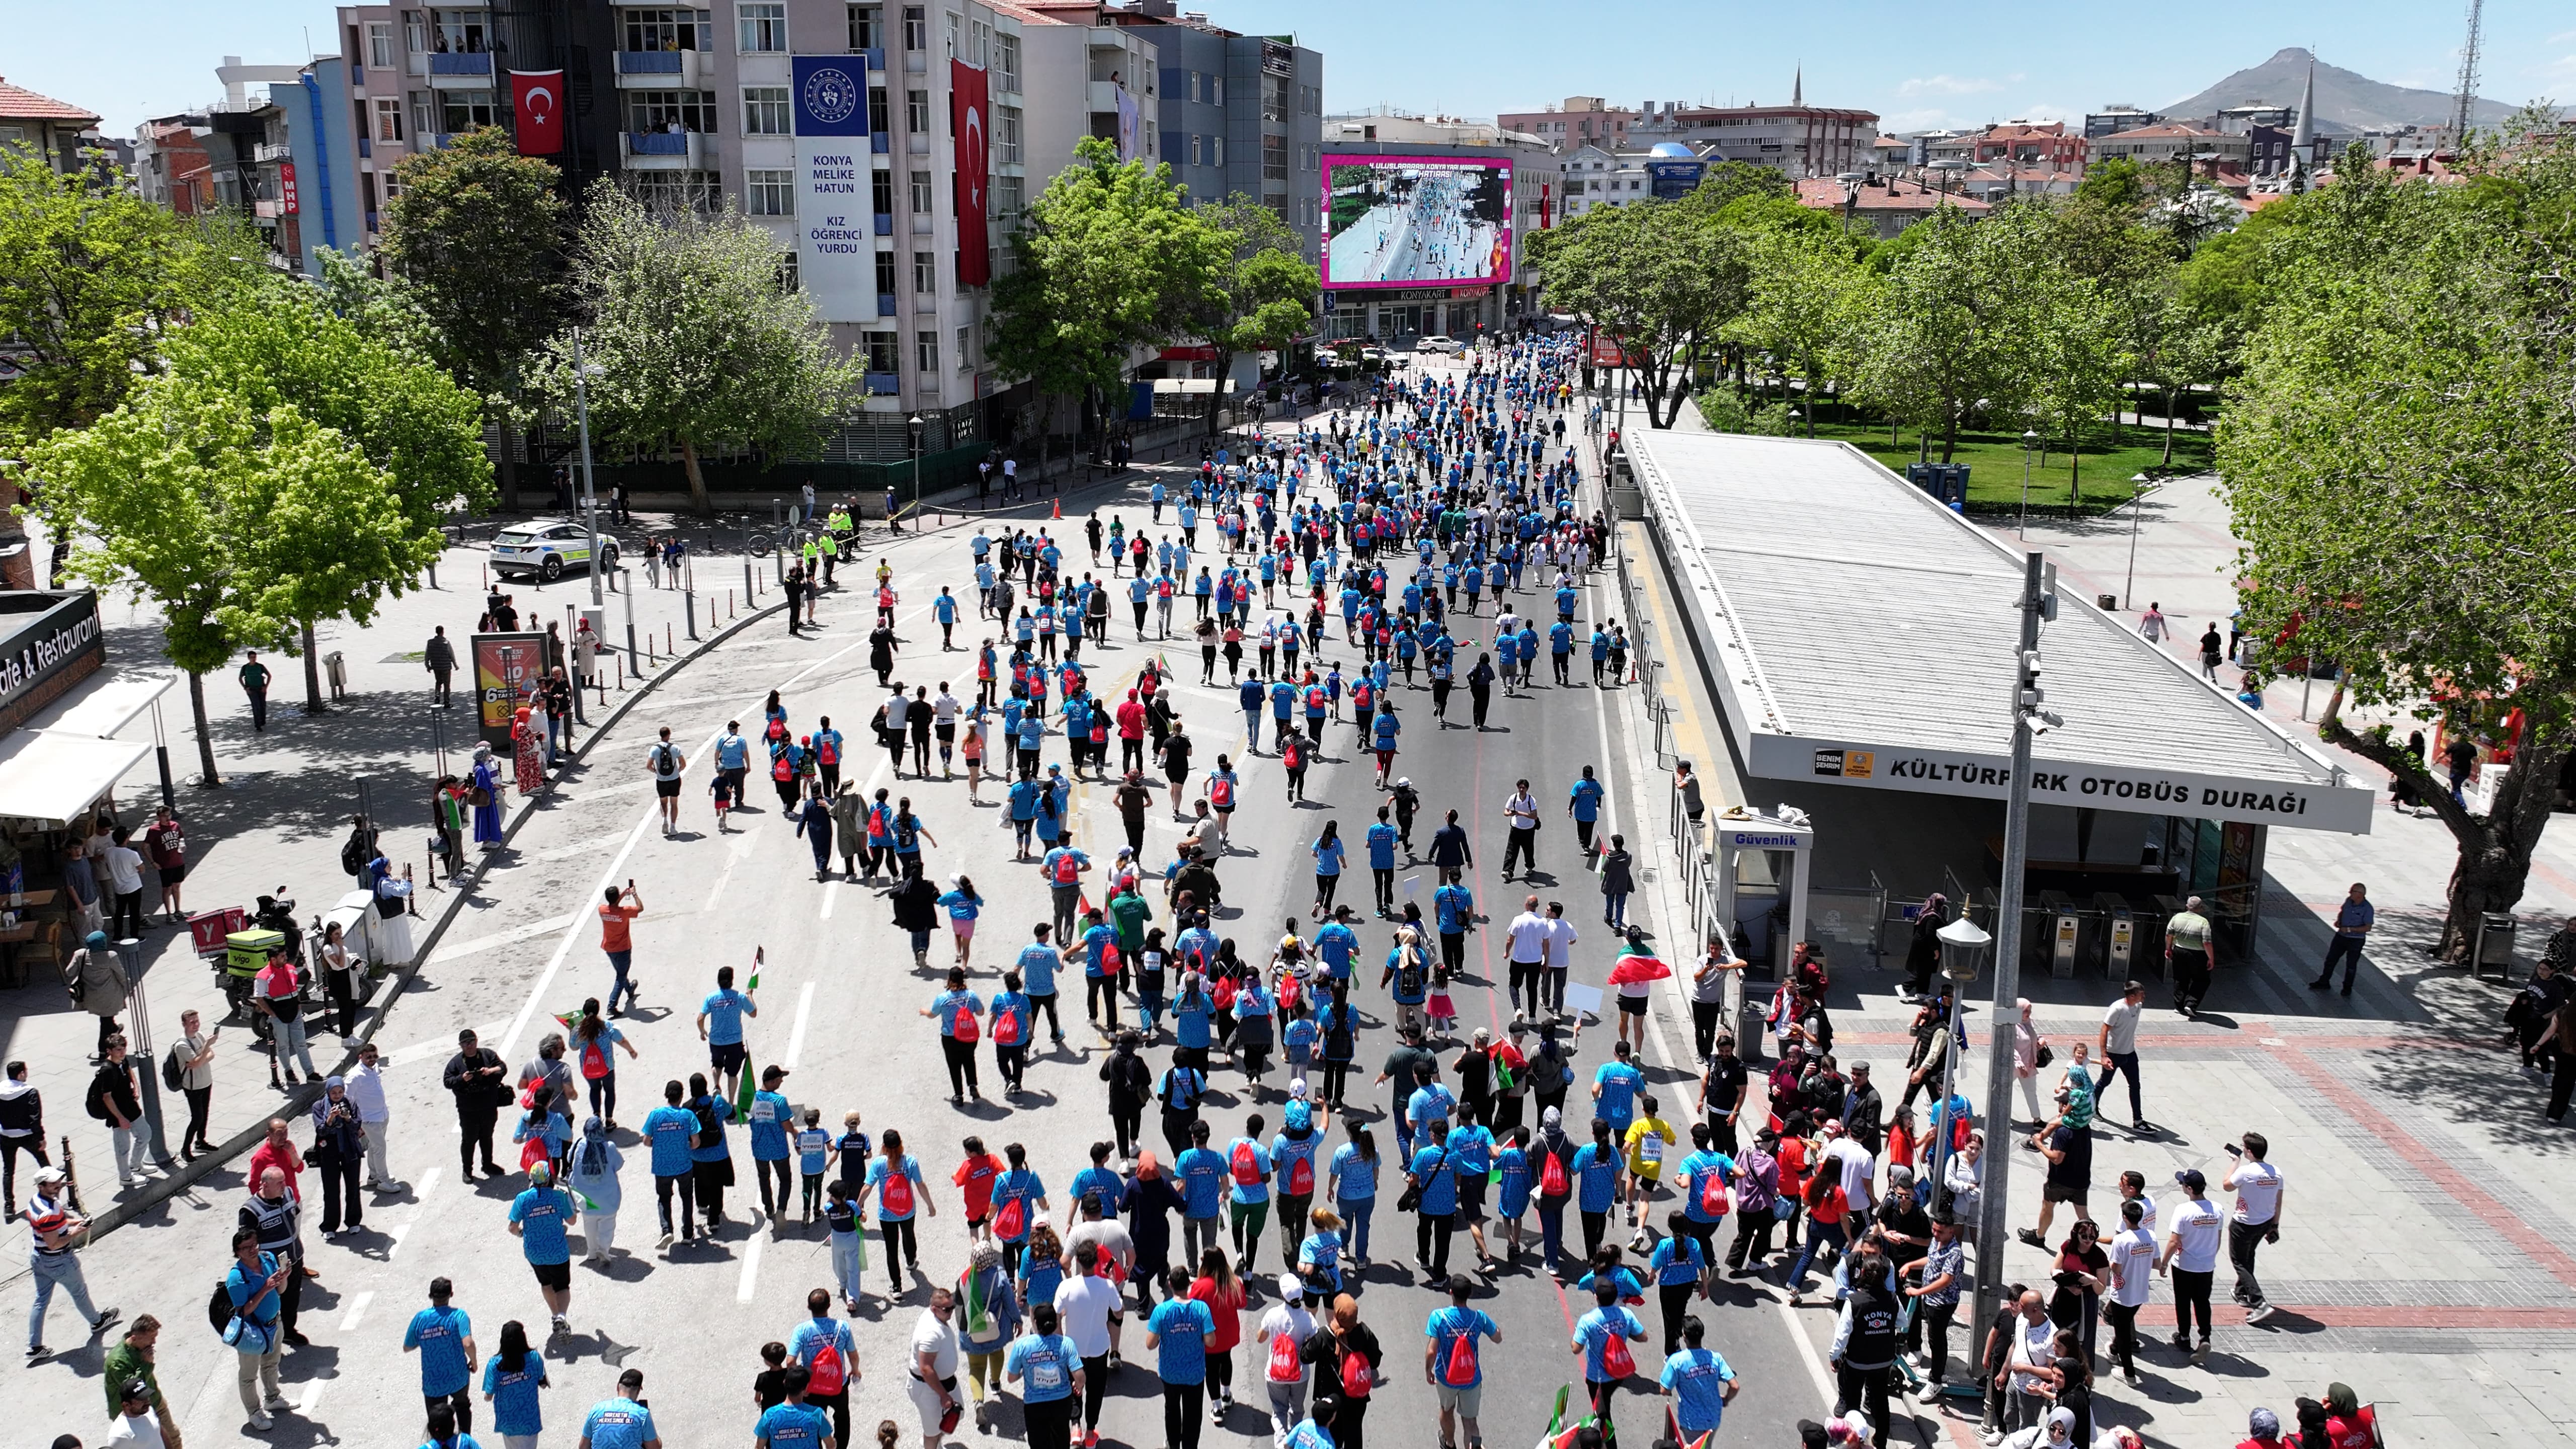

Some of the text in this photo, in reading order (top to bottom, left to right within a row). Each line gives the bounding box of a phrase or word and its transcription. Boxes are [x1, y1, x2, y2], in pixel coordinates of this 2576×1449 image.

[814, 155, 853, 166] KONYA
[813, 168, 854, 179] MELİKE
[815, 184, 854, 193] HATUN
[284, 181, 296, 211] MHP
[827, 216, 845, 226] KIZ
[811, 228, 862, 240] ÖĞRENCİ
[817, 244, 857, 253] YURDU
[1401, 289, 1445, 300] KONYAKART
[1460, 286, 1490, 297] KONYAKART
[0, 659, 21, 695] afe
[23, 649, 36, 679] &
[35, 606, 99, 671] Restaurant
[486, 687, 497, 703] 6
[1816, 755, 1841, 763] BENİM
[1890, 758, 2306, 815] KÜLTÜRPRK OTOBÜS DURAĞI
[1735, 834, 1797, 845] Güvenlik
[233, 954, 250, 964] vigo
[1864, 1312, 1892, 1321] KONYA
